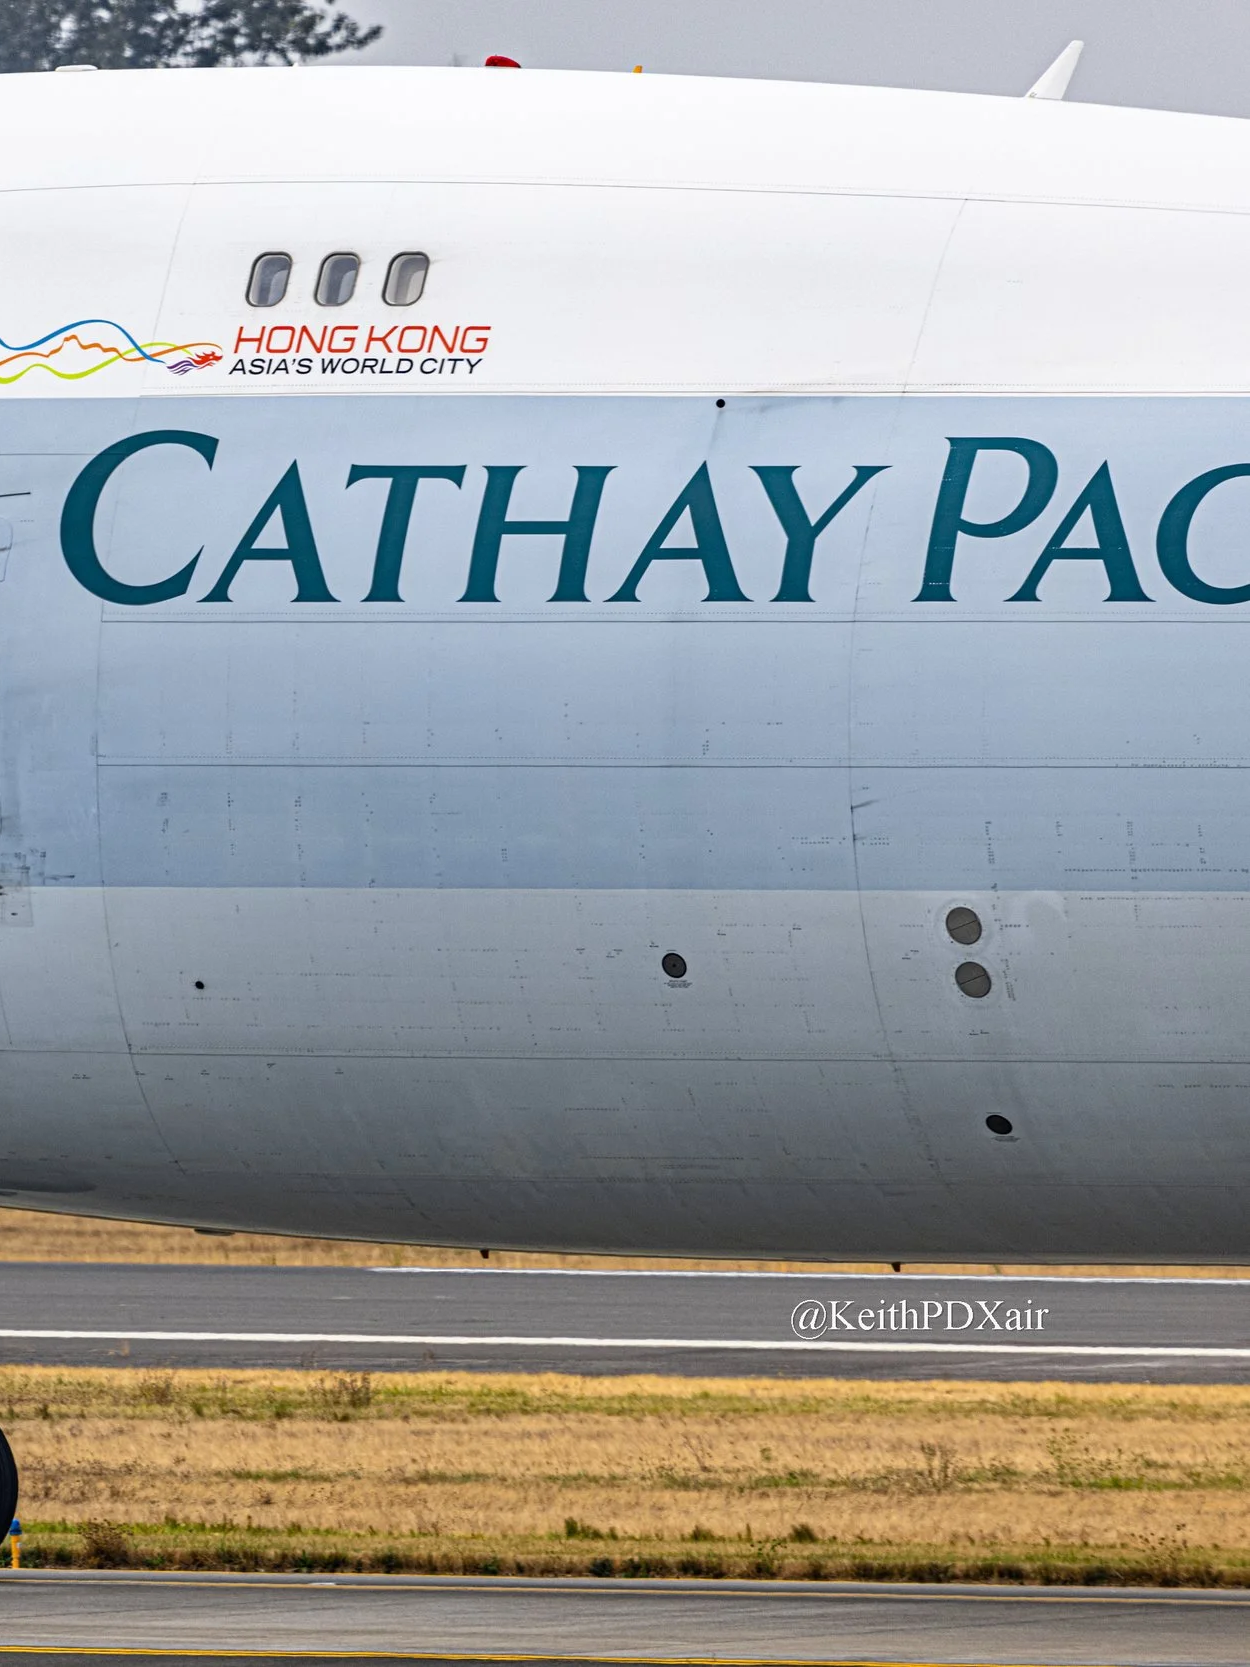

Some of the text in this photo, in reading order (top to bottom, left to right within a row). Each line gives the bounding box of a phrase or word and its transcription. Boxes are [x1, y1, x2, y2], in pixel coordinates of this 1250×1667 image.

[233, 325, 492, 354] HONG KONG
[228, 357, 483, 375] ASIA'S WORLD CITY
[60, 429, 893, 606] CATHAY
